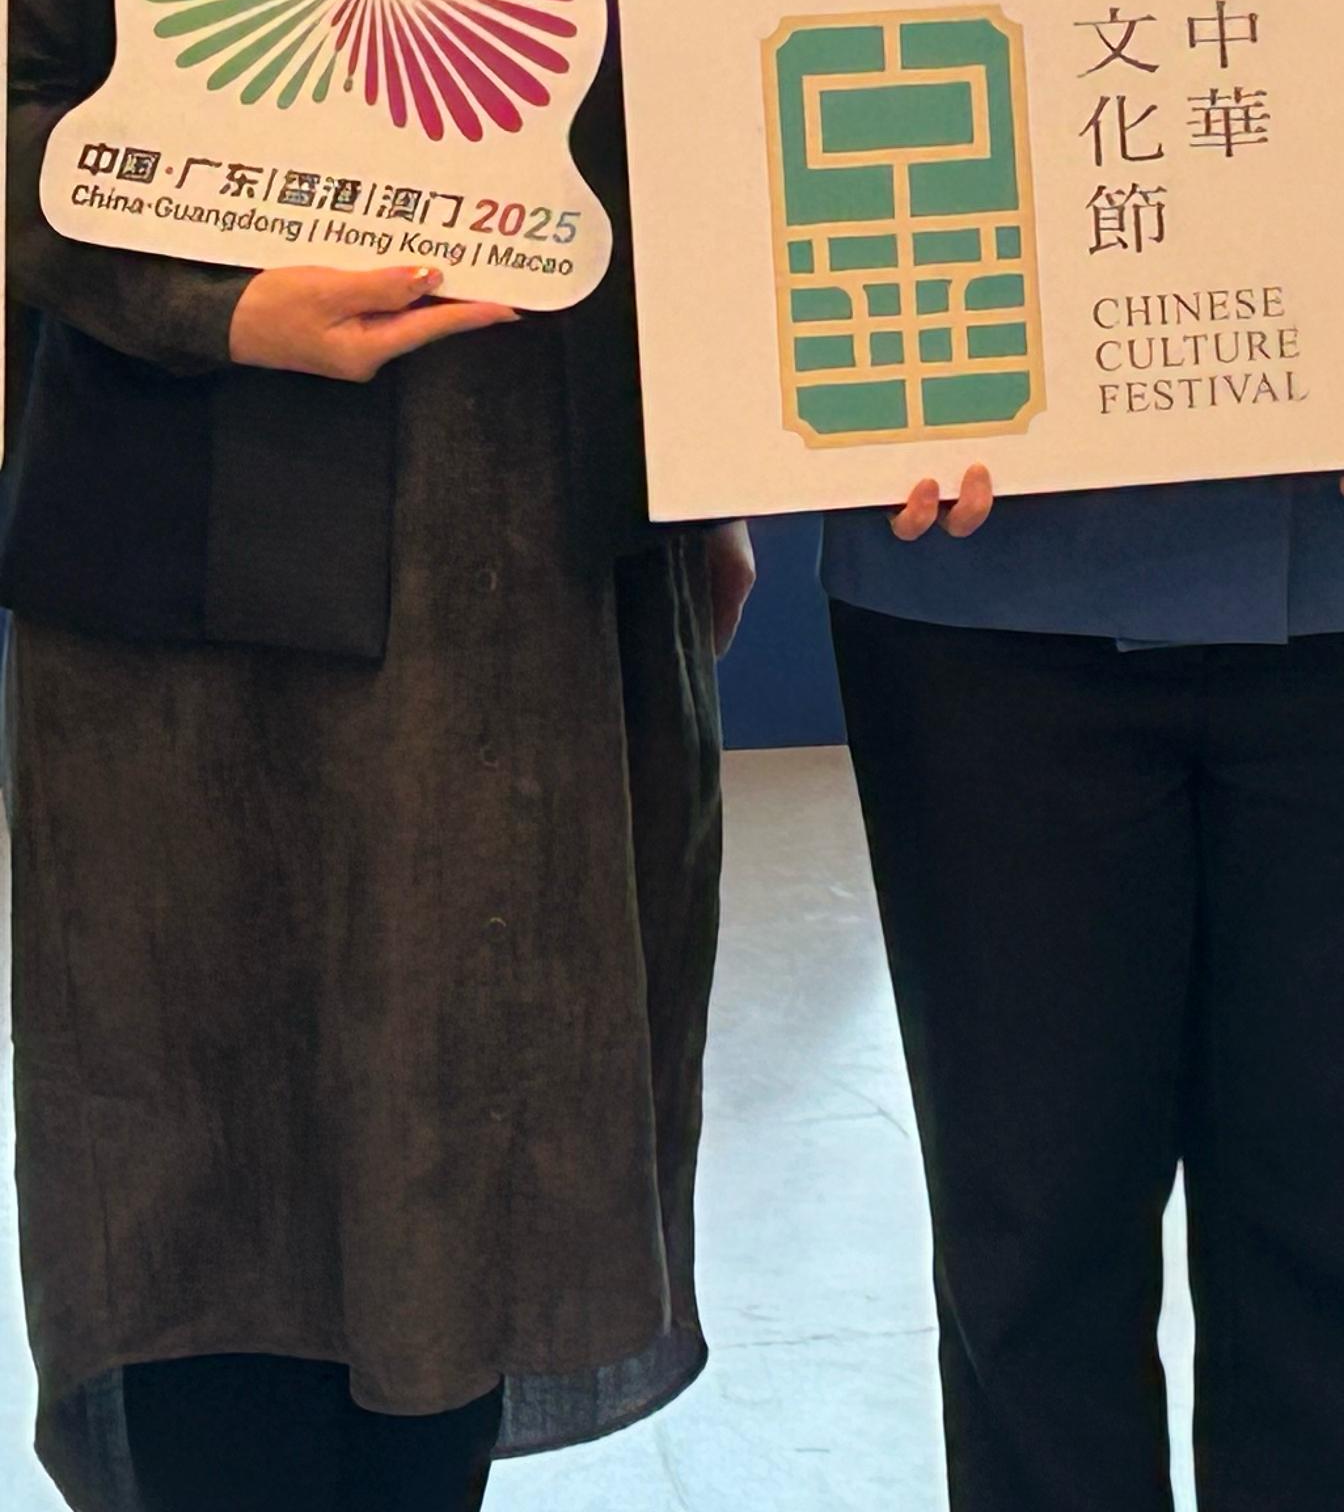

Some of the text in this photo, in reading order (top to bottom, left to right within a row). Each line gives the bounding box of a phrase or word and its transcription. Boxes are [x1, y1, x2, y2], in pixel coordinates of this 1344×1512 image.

[1186, 0, 1271, 157] 中華
[1073, 7, 1167, 255] 文化節
[469, 198, 582, 244] 2025
[324, 220, 393, 255] Hong
[400, 232, 466, 266] Kong
[487, 244, 574, 276] Macao
[1093, 286, 1285, 330] CHINESE
[1095, 327, 1300, 372] CULTURE
[1099, 371, 1310, 414] FESTIVAL
